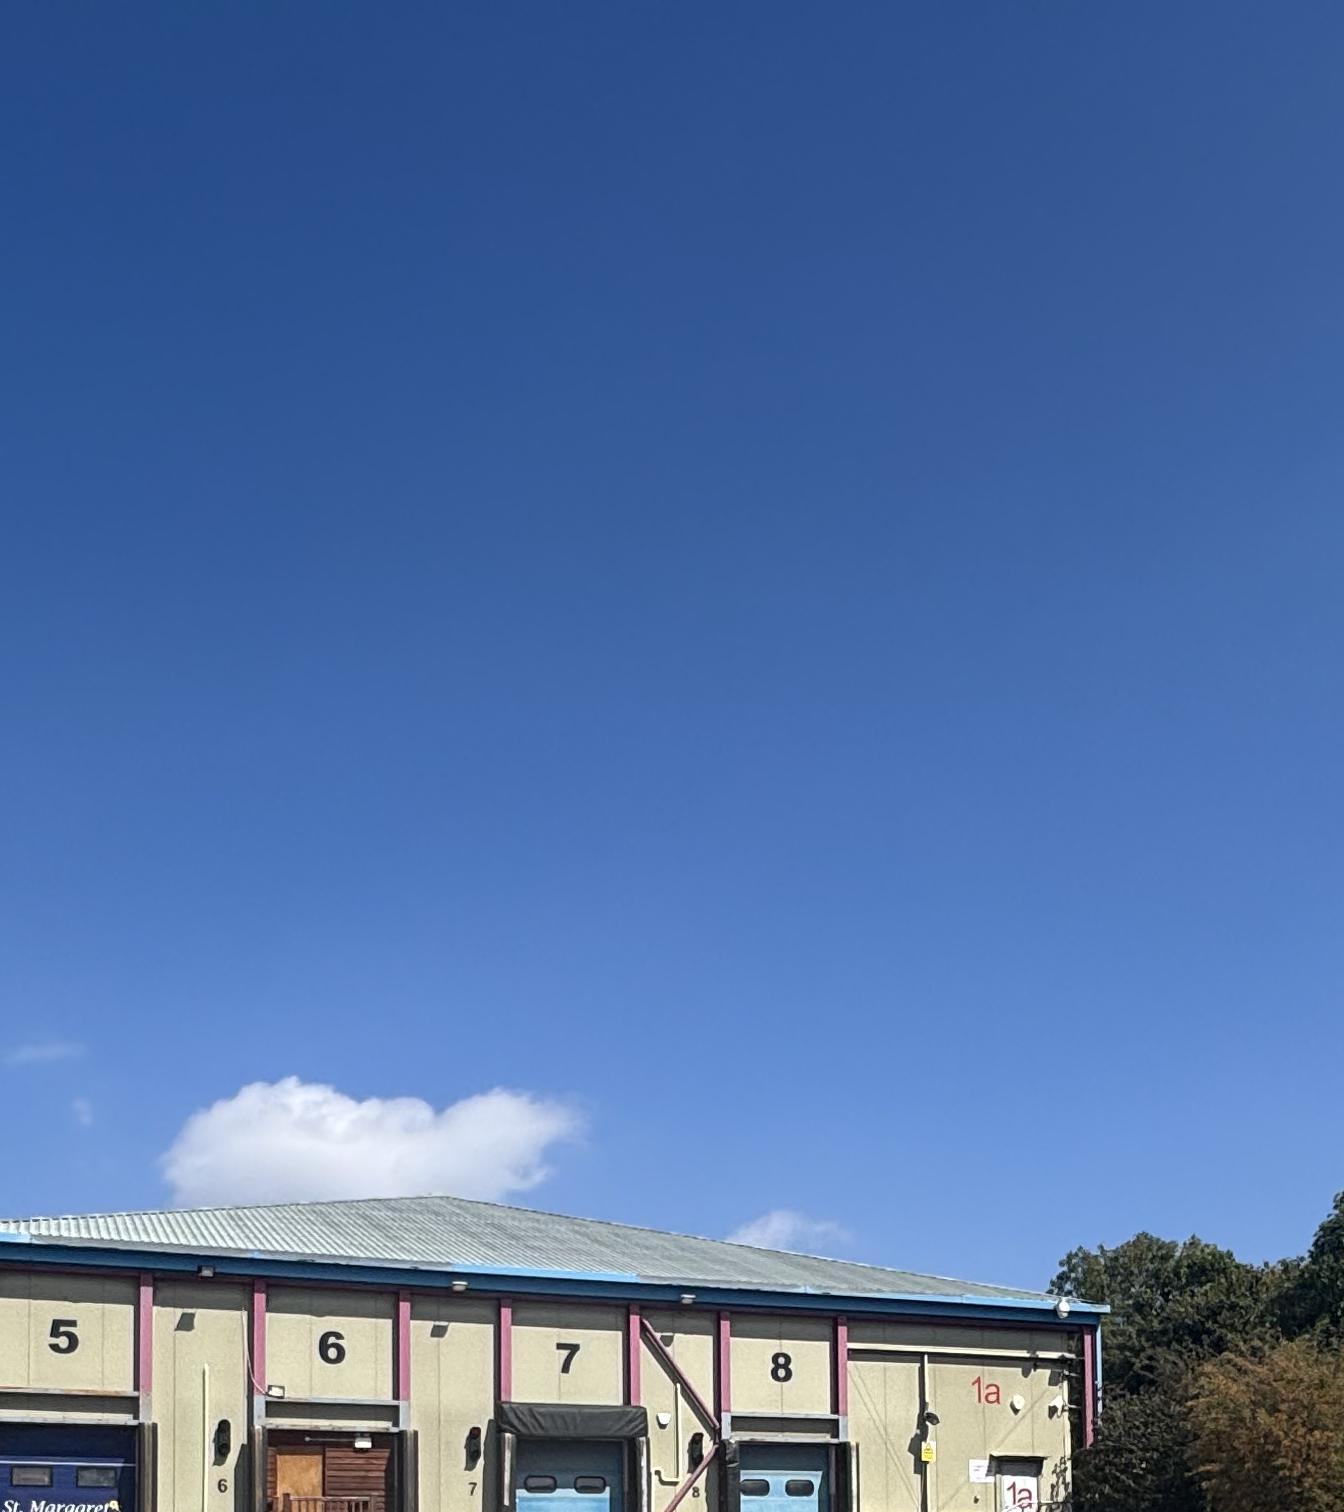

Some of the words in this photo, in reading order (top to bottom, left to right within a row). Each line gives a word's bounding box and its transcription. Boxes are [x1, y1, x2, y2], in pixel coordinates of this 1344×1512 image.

[48, 1318, 79, 1354] 5
[318, 1331, 346, 1365] 6
[556, 1342, 580, 1374] 7
[770, 1352, 793, 1383] 8
[971, 1376, 1001, 1404] 1a
[217, 1478, 228, 1493] 6
[468, 1482, 478, 1496] 7
[691, 1486, 700, 1498] 8
[1006, 1481, 1033, 1509] 1a
